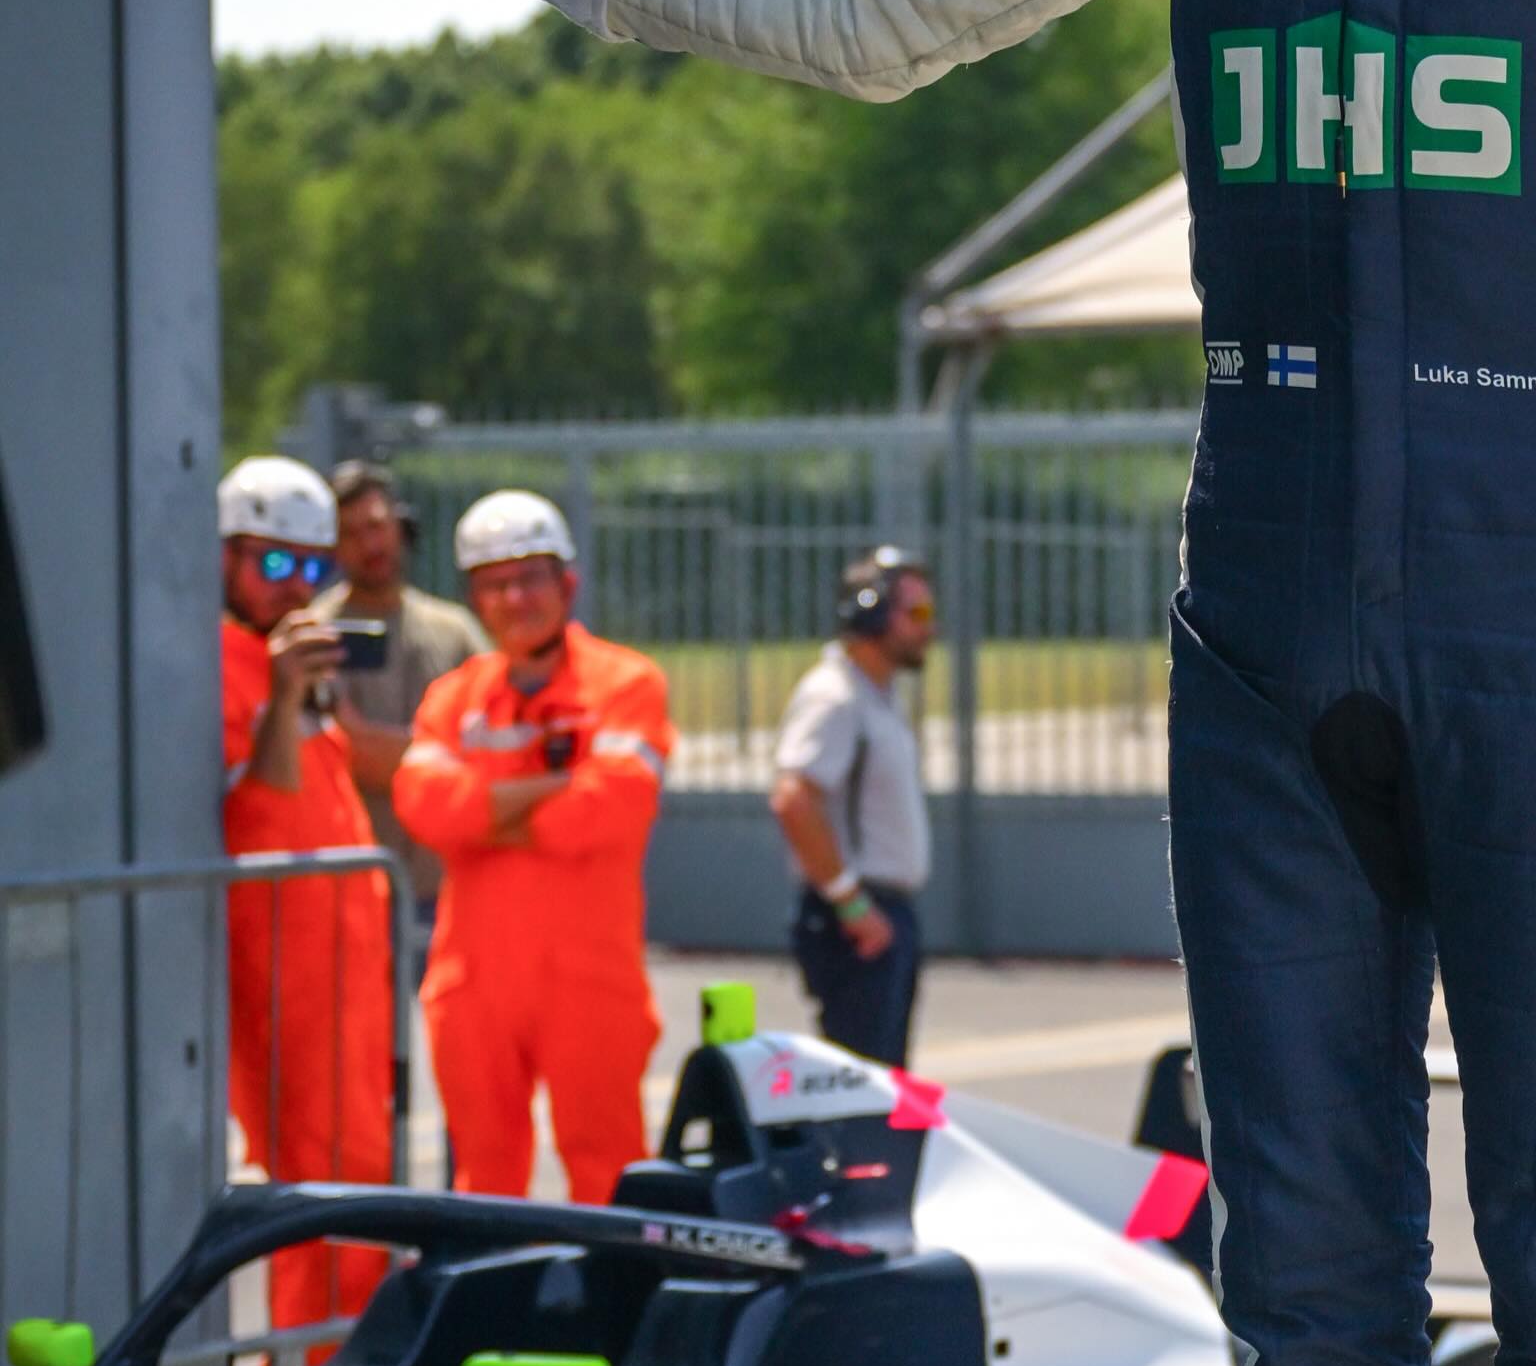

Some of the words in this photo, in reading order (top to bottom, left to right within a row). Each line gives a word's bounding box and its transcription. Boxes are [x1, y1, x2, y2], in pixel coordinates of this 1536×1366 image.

[1220, 45, 1513, 180] JHS
[1207, 348, 1245, 377] OMP
[1413, 363, 1470, 385] Luka
